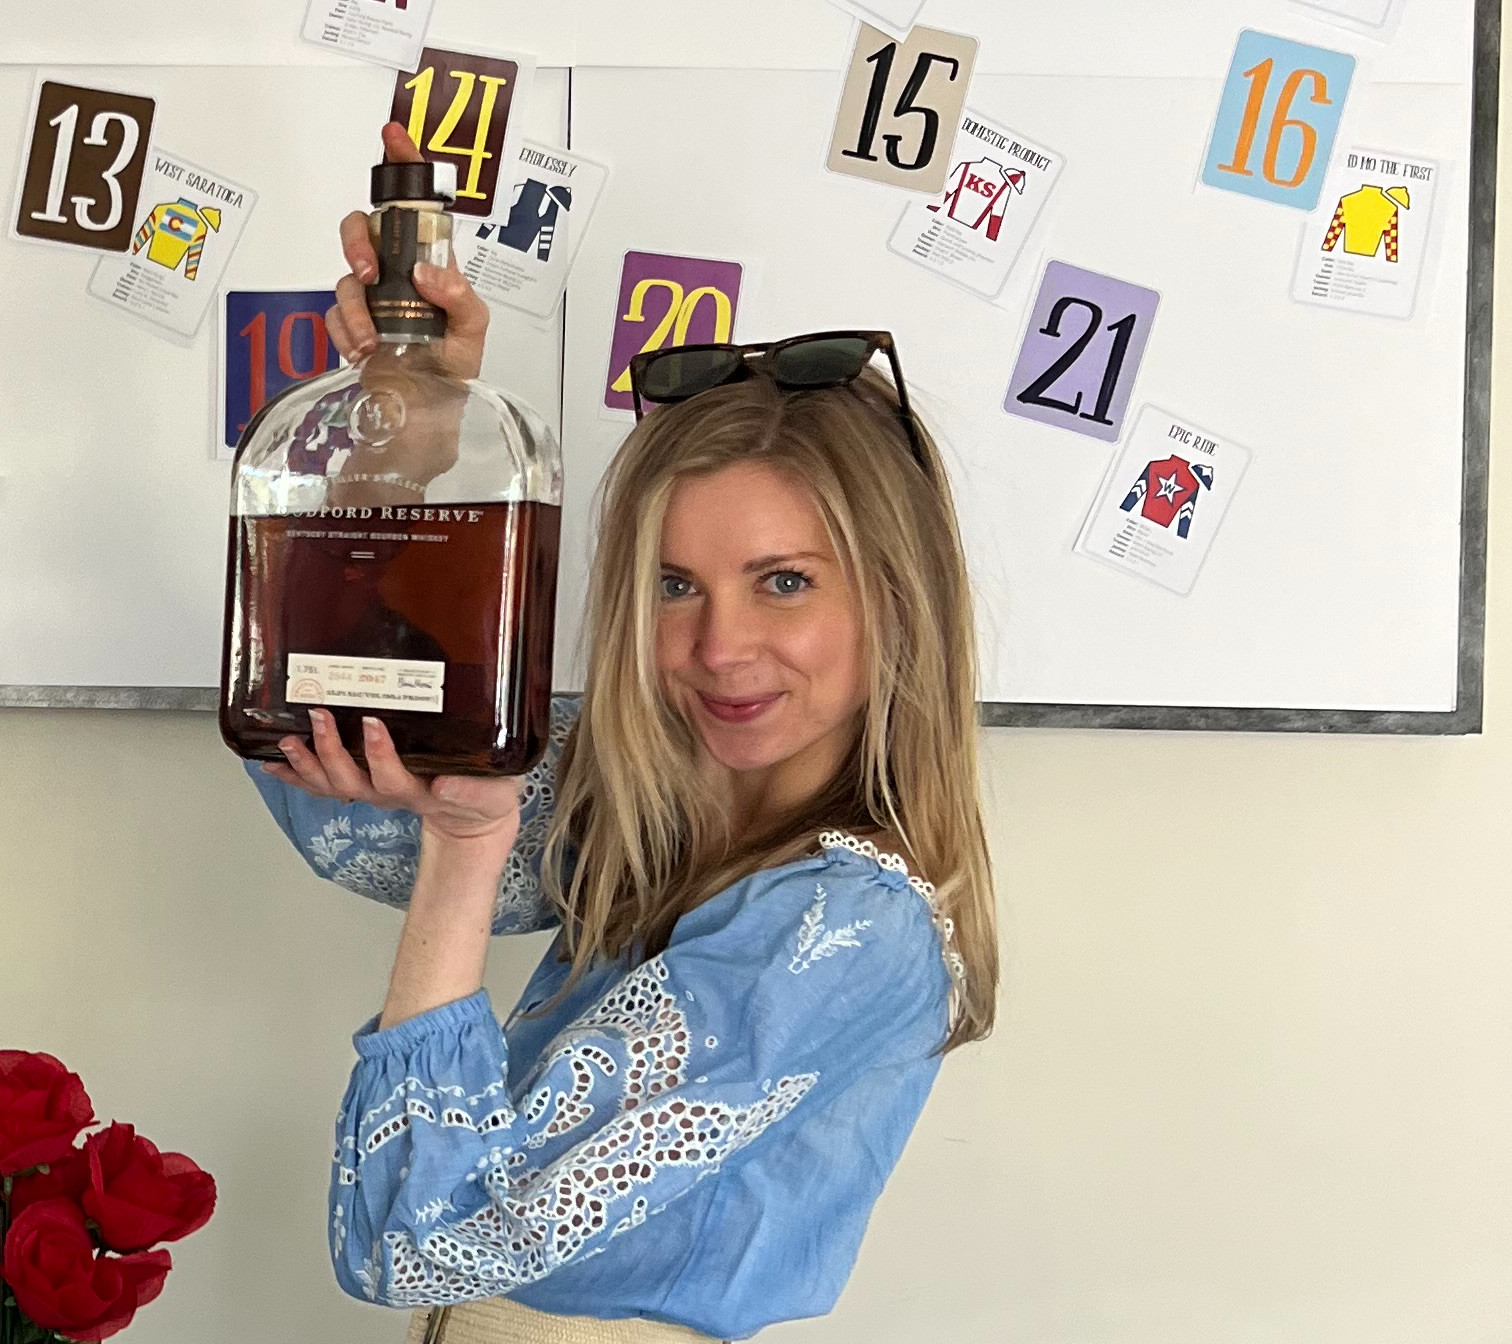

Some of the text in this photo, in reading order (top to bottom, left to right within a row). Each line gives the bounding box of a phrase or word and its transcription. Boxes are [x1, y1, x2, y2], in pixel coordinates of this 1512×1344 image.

[404, 66, 507, 200] 14
[842, 42, 959, 171] 15
[1217, 57, 1333, 187] 16
[31, 104, 139, 231] 13
[518, 147, 578, 178] ENDLESSLY
[961, 117, 1052, 172] DOMESTIC PRODUCT
[1380, 160, 1401, 176] THE
[1403, 164, 1434, 181] FIRST
[154, 157, 244, 209] WEST SARATOGA
[964, 173, 997, 198] KS
[1017, 297, 1138, 426] 21
[1168, 425, 1219, 456] EPIC RIDE
